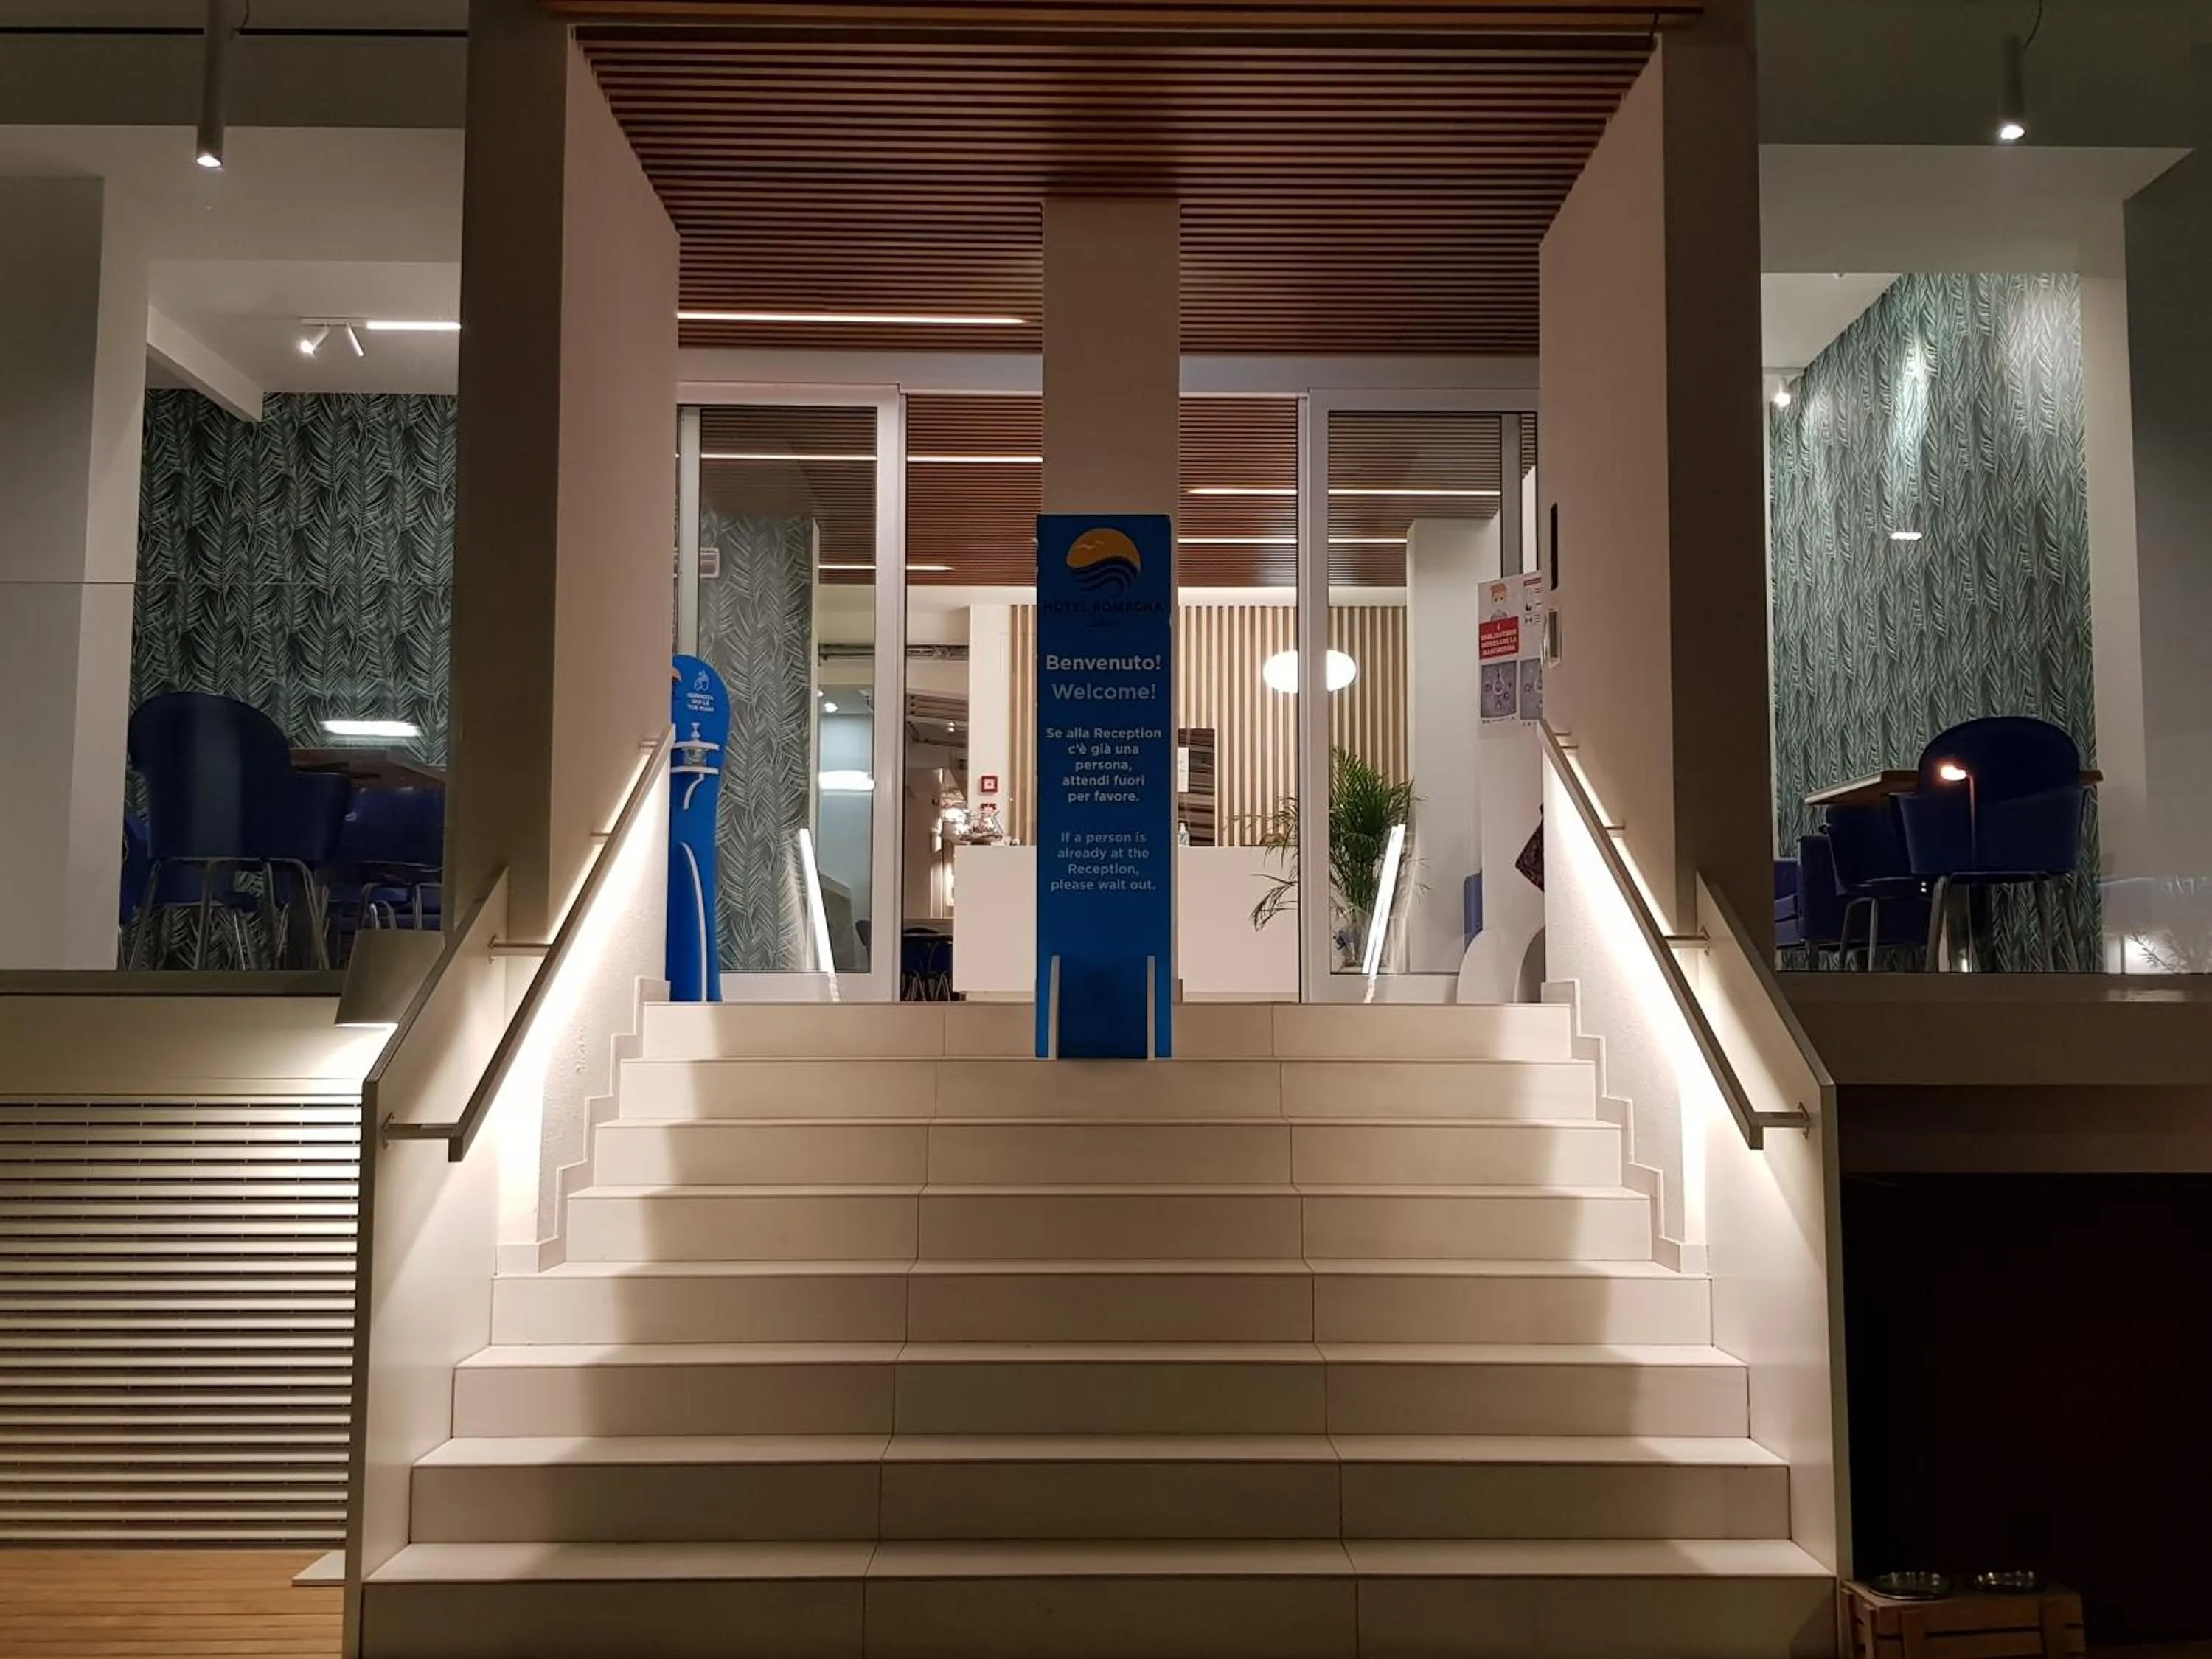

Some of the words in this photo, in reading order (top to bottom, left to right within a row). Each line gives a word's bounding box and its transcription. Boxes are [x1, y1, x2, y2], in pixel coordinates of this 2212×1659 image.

[1043, 601, 1085, 613] HOTEL
[1046, 654, 1161, 671] Benvenuto!
[1051, 683, 1156, 700] Welcome!
[1046, 728, 1062, 739] Se
[1065, 727, 1090, 739] alla
[1093, 726, 1161, 741] Reception
[1091, 742, 1112, 757] già
[1115, 745, 1139, 755] una
[1074, 761, 1133, 773] persona,
[1062, 774, 1110, 786] attendi
[1113, 774, 1145, 786] fuori
[1068, 793, 1091, 804] per
[1093, 790, 1140, 802] favore.
[1061, 832, 1071, 844] If
[1074, 834, 1082, 843] a
[1085, 833, 1132, 845] person
[1135, 831, 1147, 843] is
[1057, 846, 1107, 860] already
[1110, 847, 1124, 859] at
[1127, 847, 1150, 859] the
[1068, 863, 1140, 877] Reception,
[1051, 878, 1094, 892] please
[1098, 878, 1127, 890] wait
[1130, 879, 1157, 891] out.
